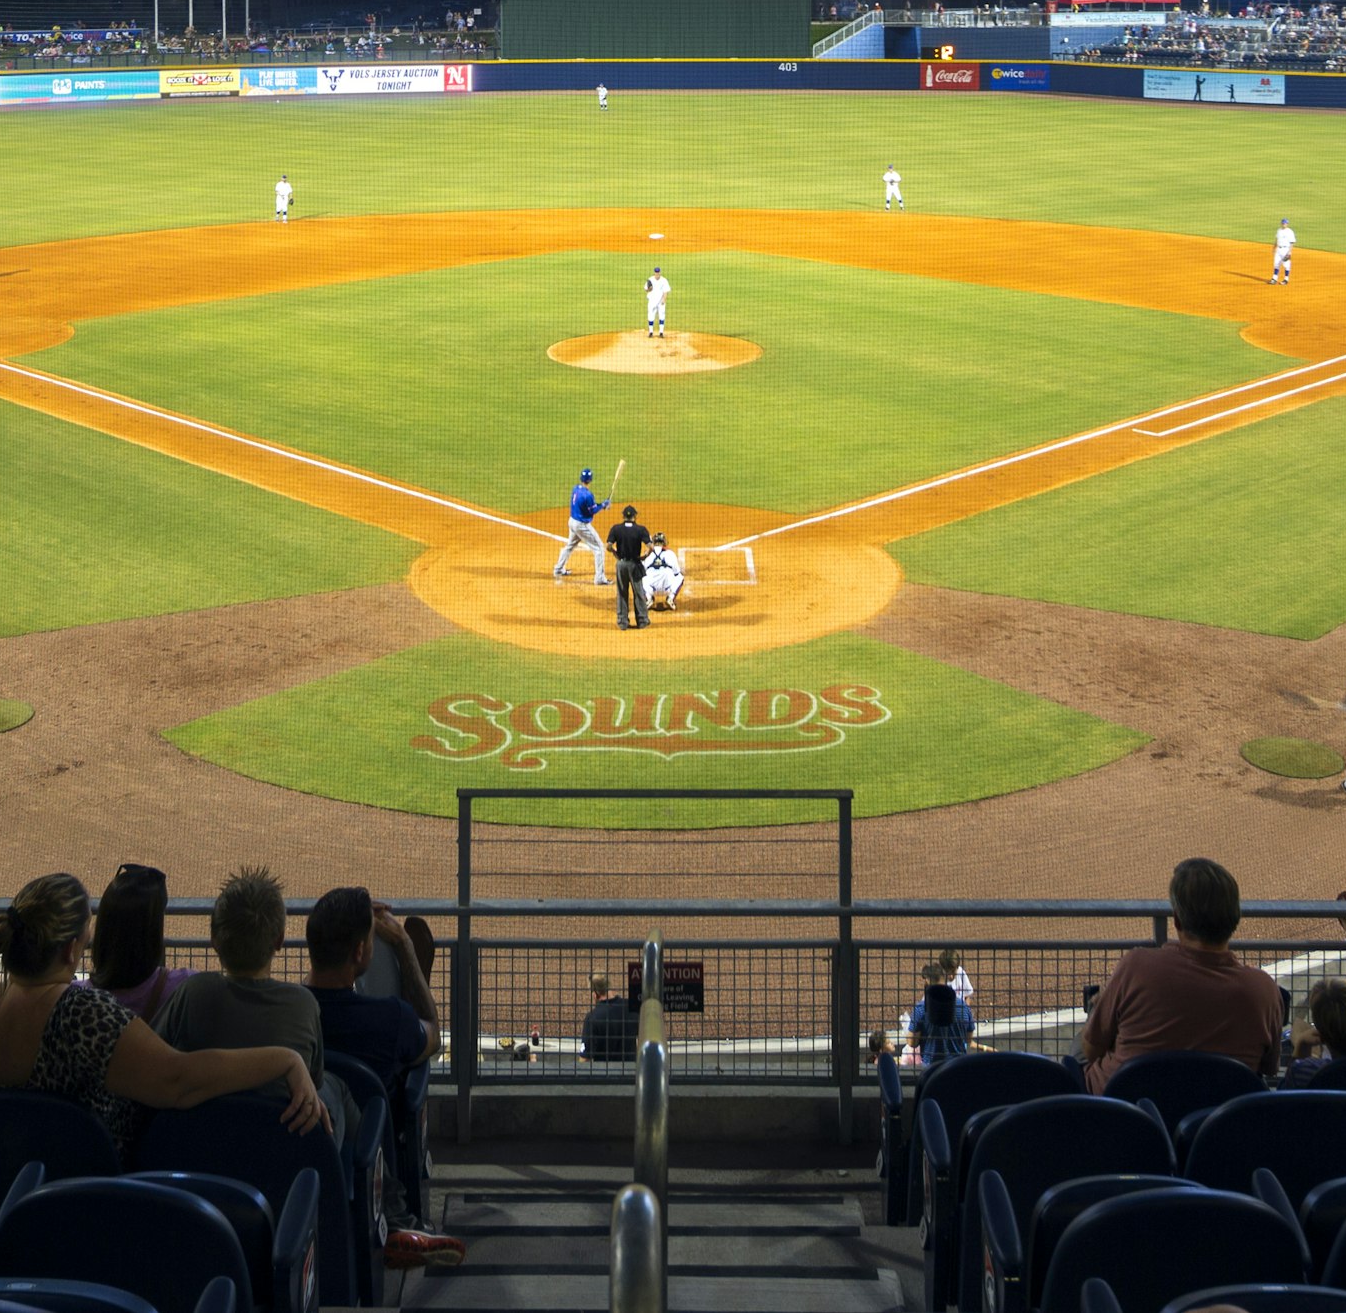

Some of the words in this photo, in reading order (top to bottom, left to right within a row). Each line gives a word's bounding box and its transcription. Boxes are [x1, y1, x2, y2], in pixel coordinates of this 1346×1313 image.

[778, 62, 798, 71] 403
[350, 69, 370, 79] VOLS
[371, 69, 401, 78] JERSEY
[403, 68, 439, 78] AUCTION
[75, 81, 106, 89] PAINTS
[377, 81, 412, 91] TONIGHT
[410, 684, 892, 761] SOUNDS
[631, 968, 701, 979] ATNTION
[675, 984, 684, 992] of
[666, 994, 695, 1002] Leaving
[670, 1002, 689, 1010] Field
